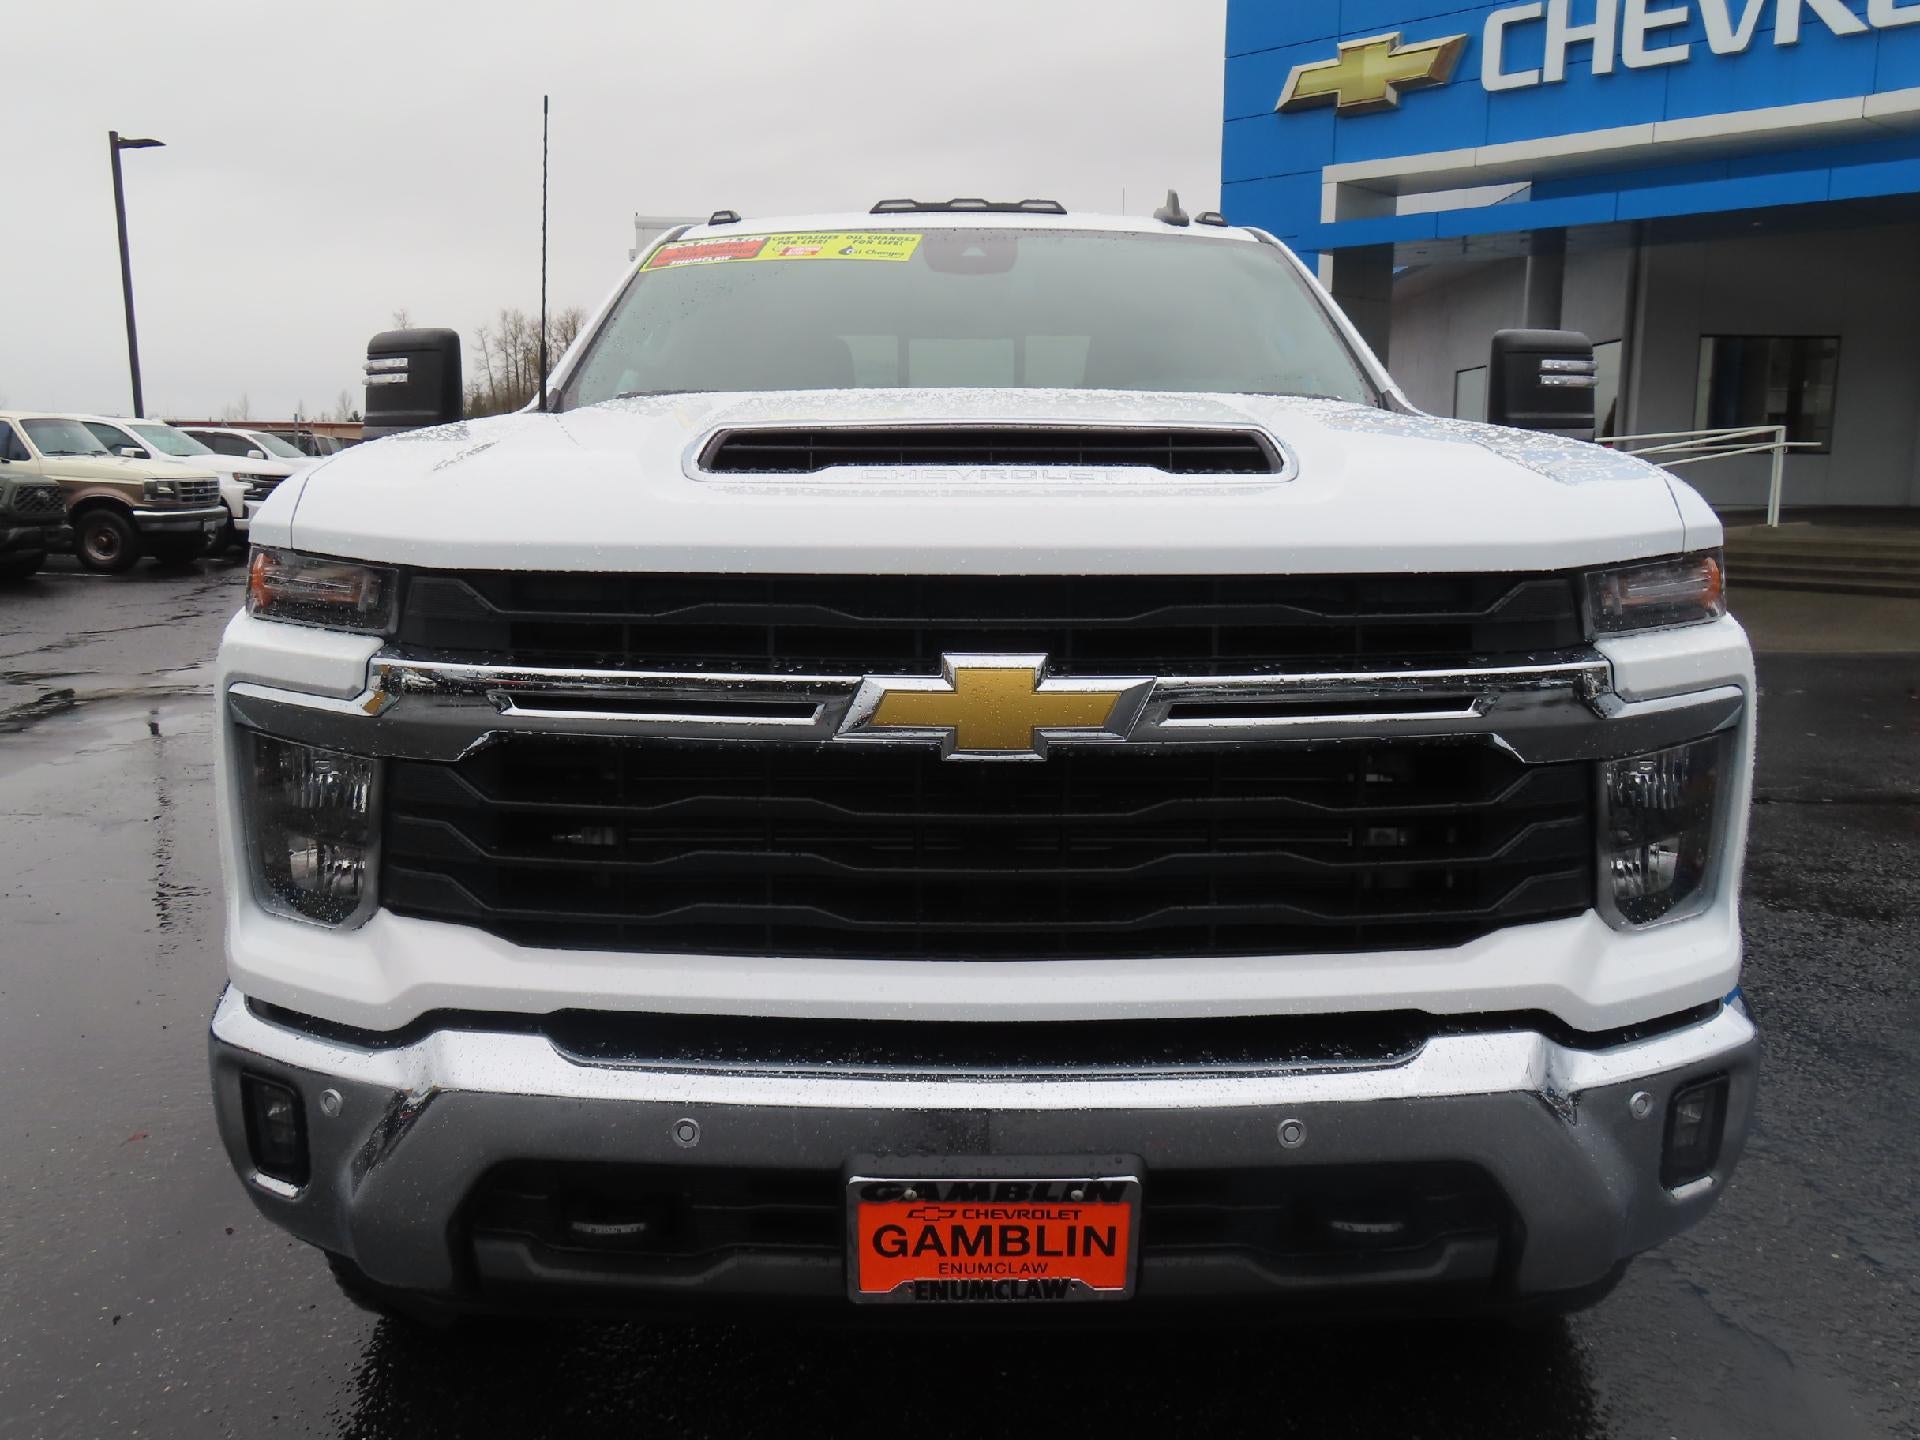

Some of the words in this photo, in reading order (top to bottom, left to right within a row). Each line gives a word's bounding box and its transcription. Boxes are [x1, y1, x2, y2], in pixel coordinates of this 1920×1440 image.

[861, 469, 1125, 480] CHEVROLET
[860, 1182, 1129, 1203] GAMBLIN
[962, 1208, 1082, 1221] CHEVROLET
[872, 1224, 1117, 1258] GAMBLIN
[939, 1262, 1049, 1274] ENUMCLAW
[914, 1278, 1072, 1300] ENUMCLAW
